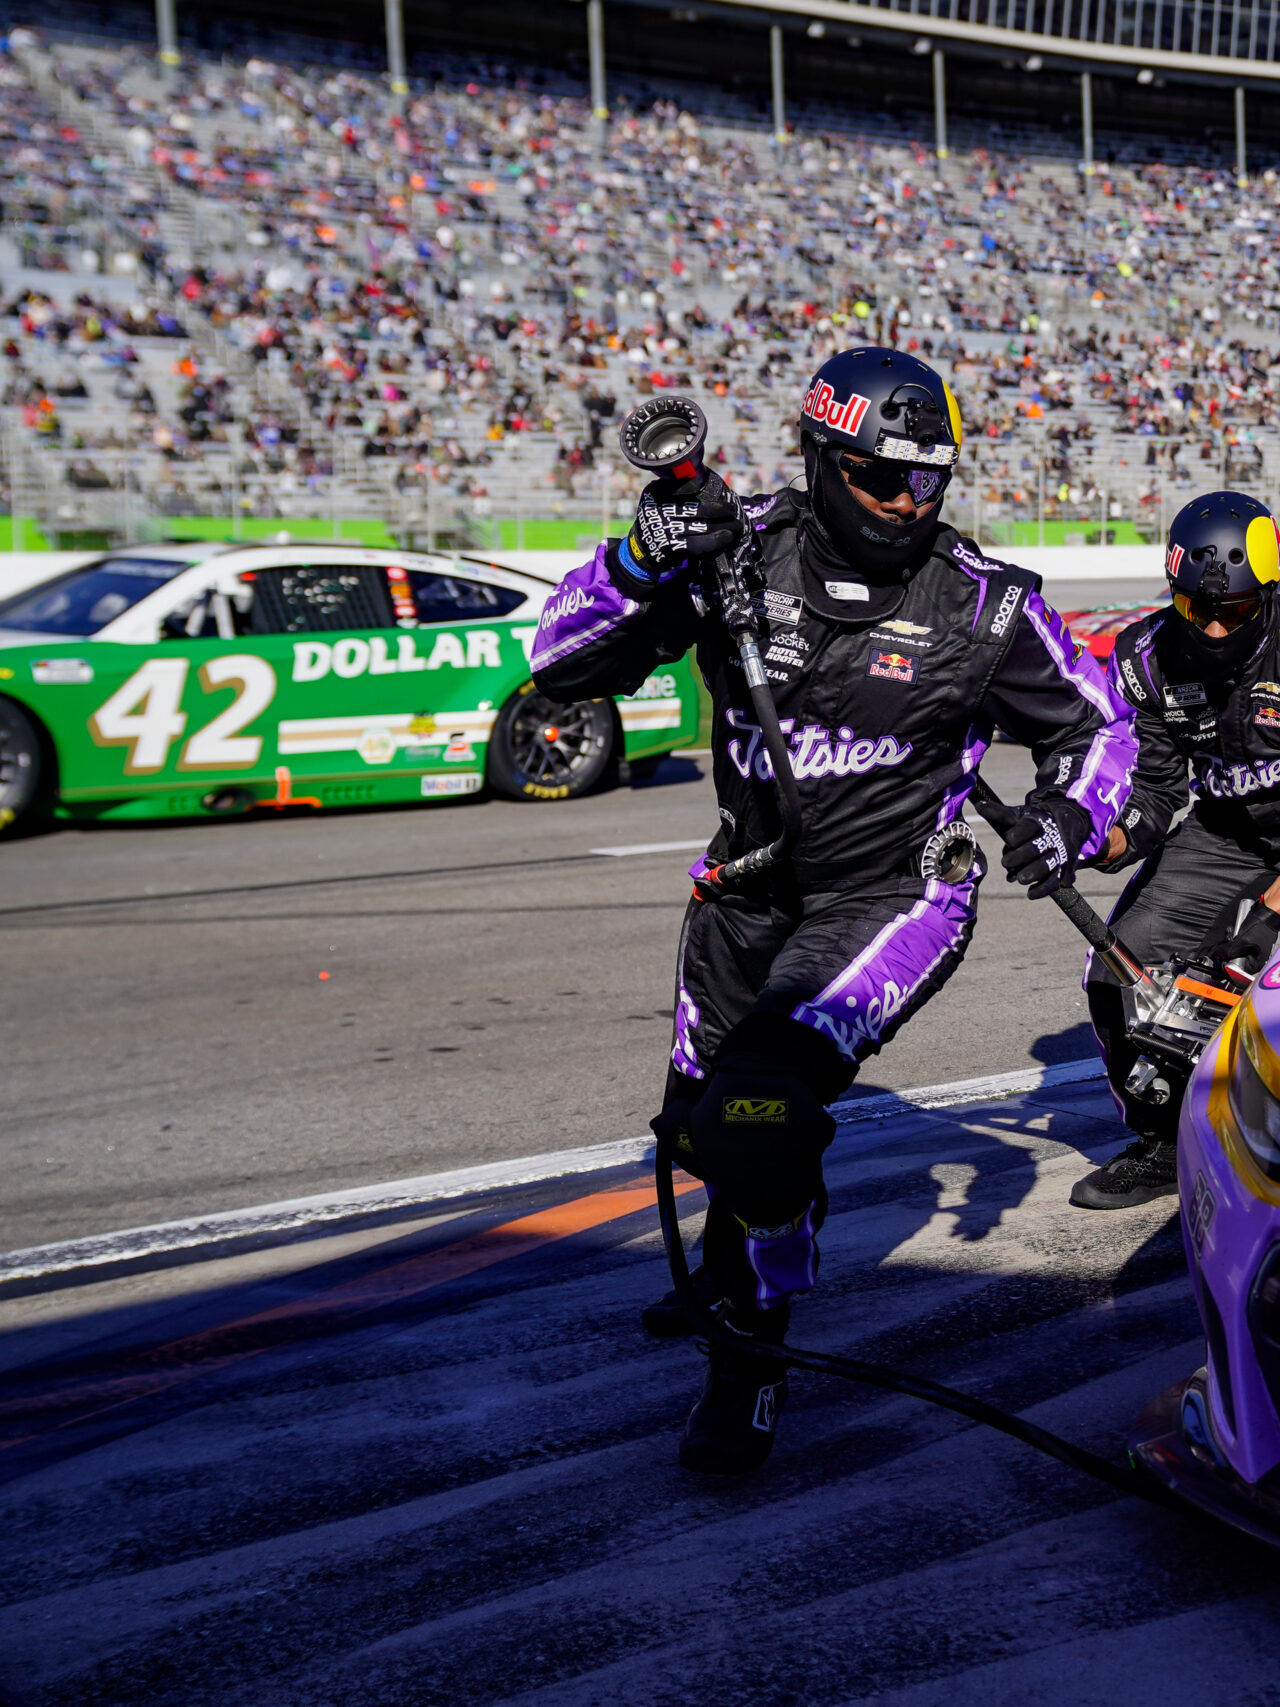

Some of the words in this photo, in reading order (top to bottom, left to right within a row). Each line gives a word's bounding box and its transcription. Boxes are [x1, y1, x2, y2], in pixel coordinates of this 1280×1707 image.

[814, 380, 873, 437] Bull
[763, 591, 795, 606] NASCAR
[991, 585, 1022, 637] sparco
[292, 629, 502, 683] DOLLAR
[770, 635, 809, 651] JOCKEY
[869, 632, 933, 648] CHEVROLET
[870, 663, 892, 679] Red
[891, 667, 914, 682] Bull
[1121, 659, 1147, 702] sparco
[87, 655, 277, 777] 42
